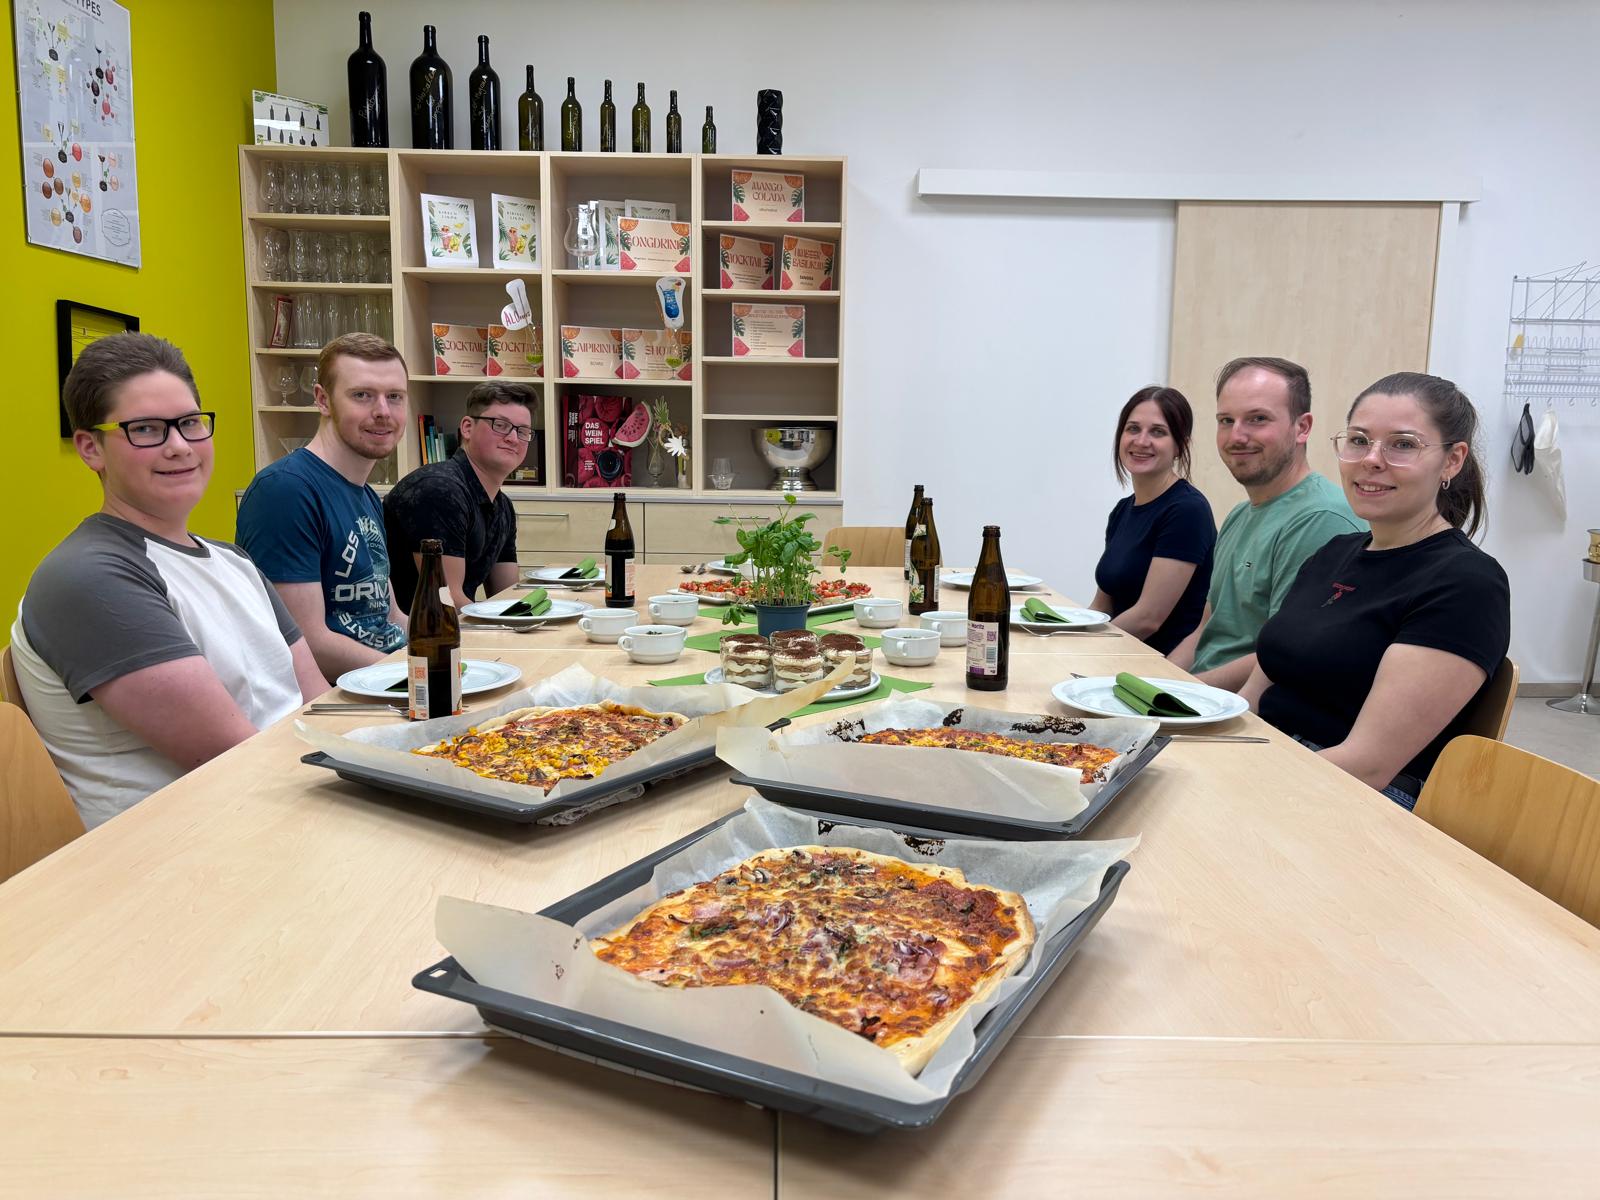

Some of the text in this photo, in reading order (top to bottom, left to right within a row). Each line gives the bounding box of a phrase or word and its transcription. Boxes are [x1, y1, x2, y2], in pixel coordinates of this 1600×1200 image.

[752, 181, 783, 192] MANGO
[752, 191, 786, 203] COLADA
[585, 429, 603, 437] WEIN
[585, 437, 605, 445] SPIEL
[335, 530, 360, 579] LOS
